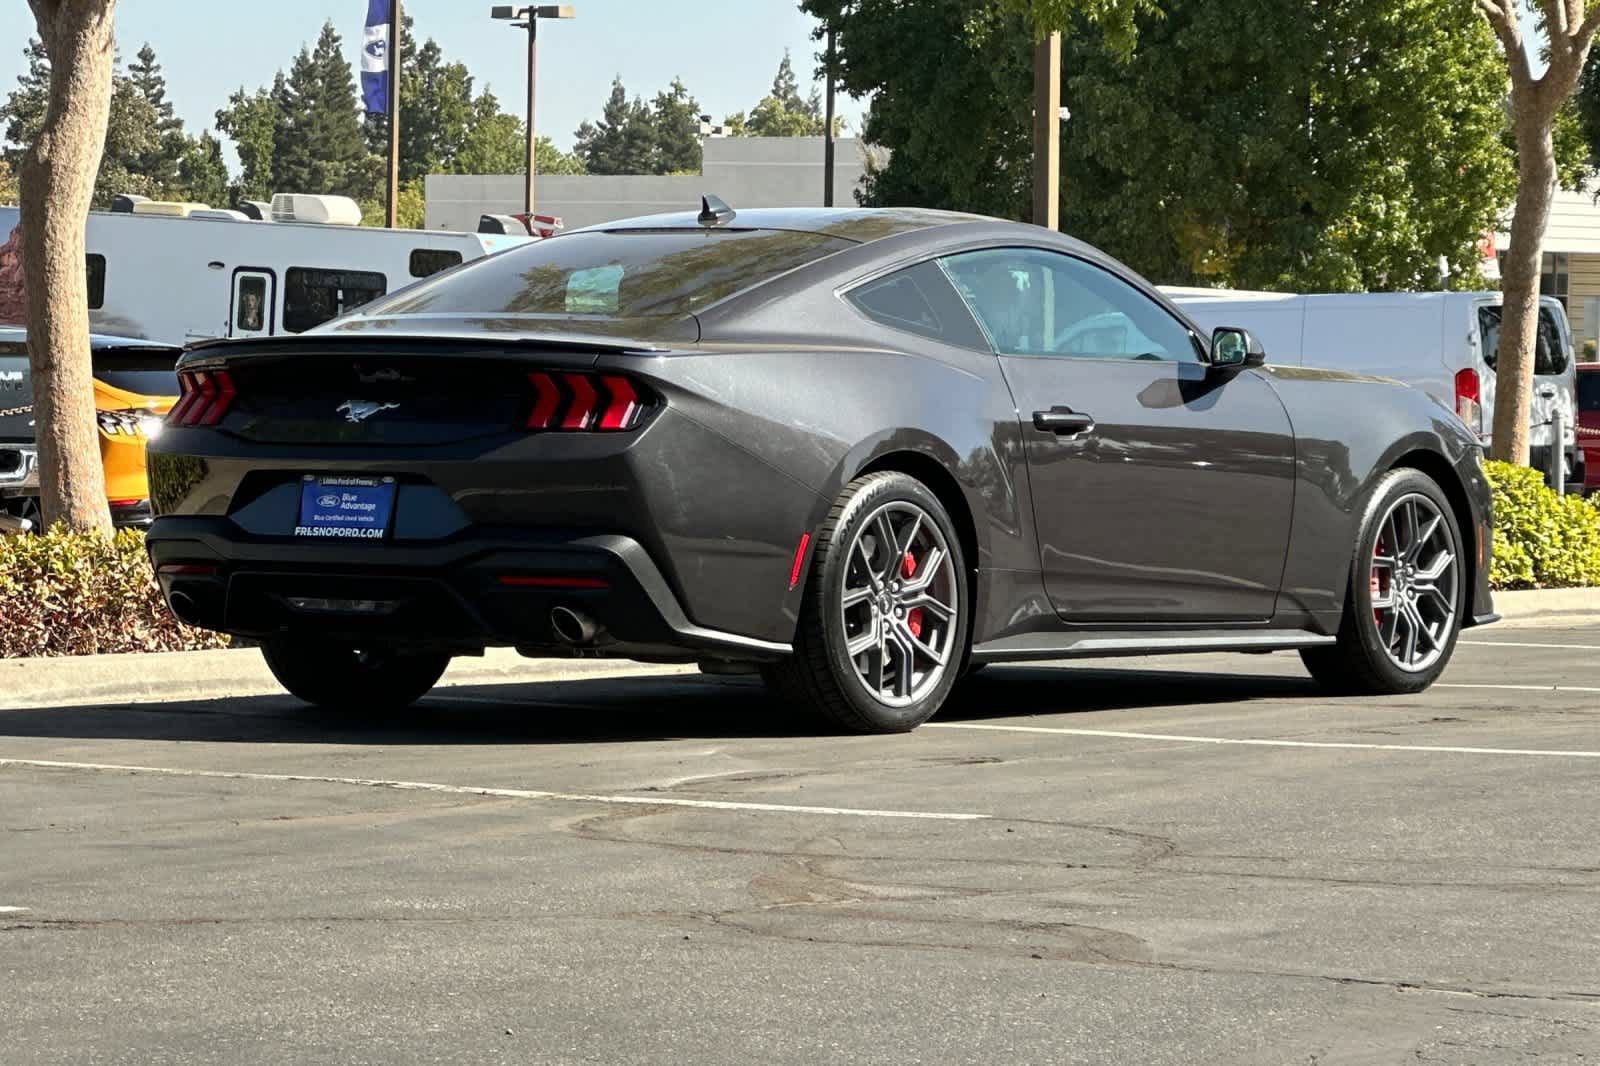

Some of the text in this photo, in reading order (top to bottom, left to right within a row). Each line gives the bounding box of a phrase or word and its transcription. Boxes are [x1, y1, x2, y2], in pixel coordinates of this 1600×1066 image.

[341, 493, 357, 501] Blue
[340, 502, 376, 511] Advantage
[295, 526, 384, 538] FRESNOFORD.COM
